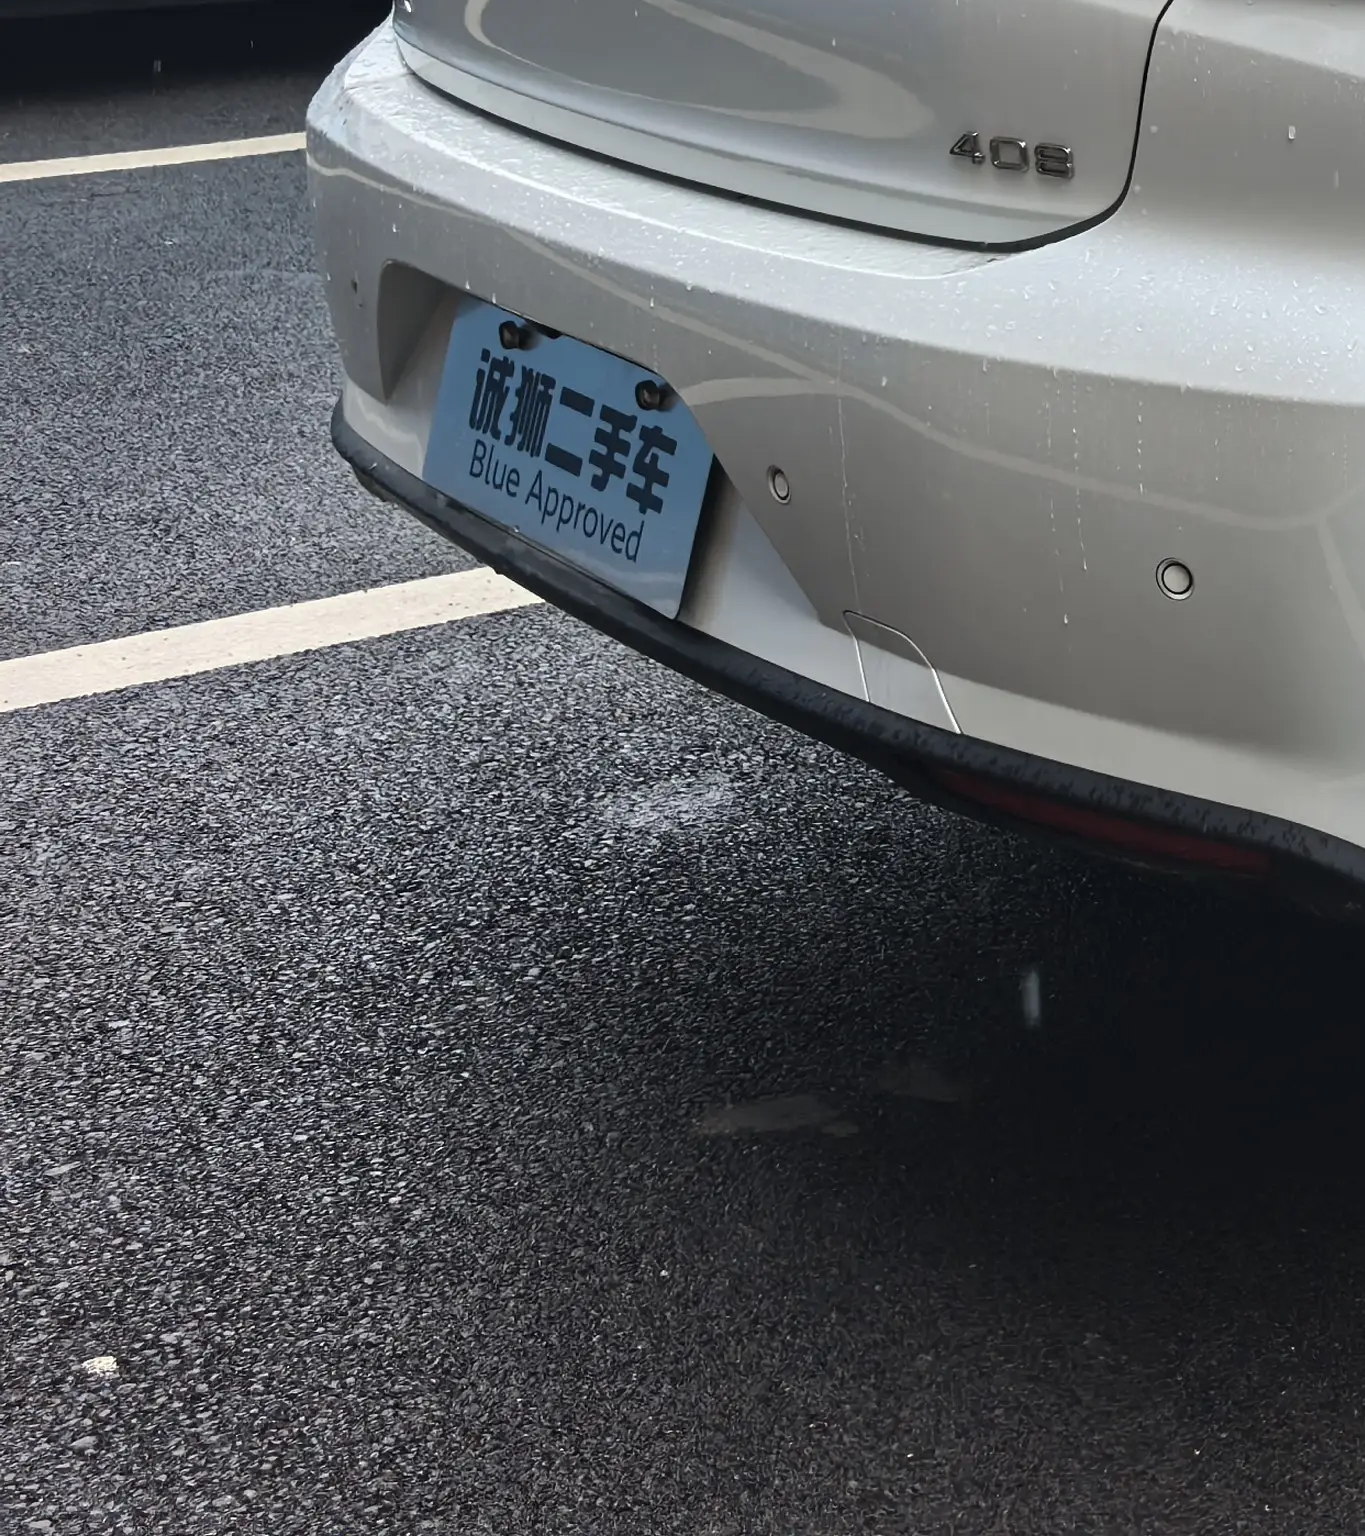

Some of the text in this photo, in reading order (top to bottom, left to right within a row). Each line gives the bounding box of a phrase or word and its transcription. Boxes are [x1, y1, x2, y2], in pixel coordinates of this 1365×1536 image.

[949, 130, 1076, 180] 408
[469, 347, 678, 516] 诚狮二手车
[469, 438, 646, 564] Blue Approved
